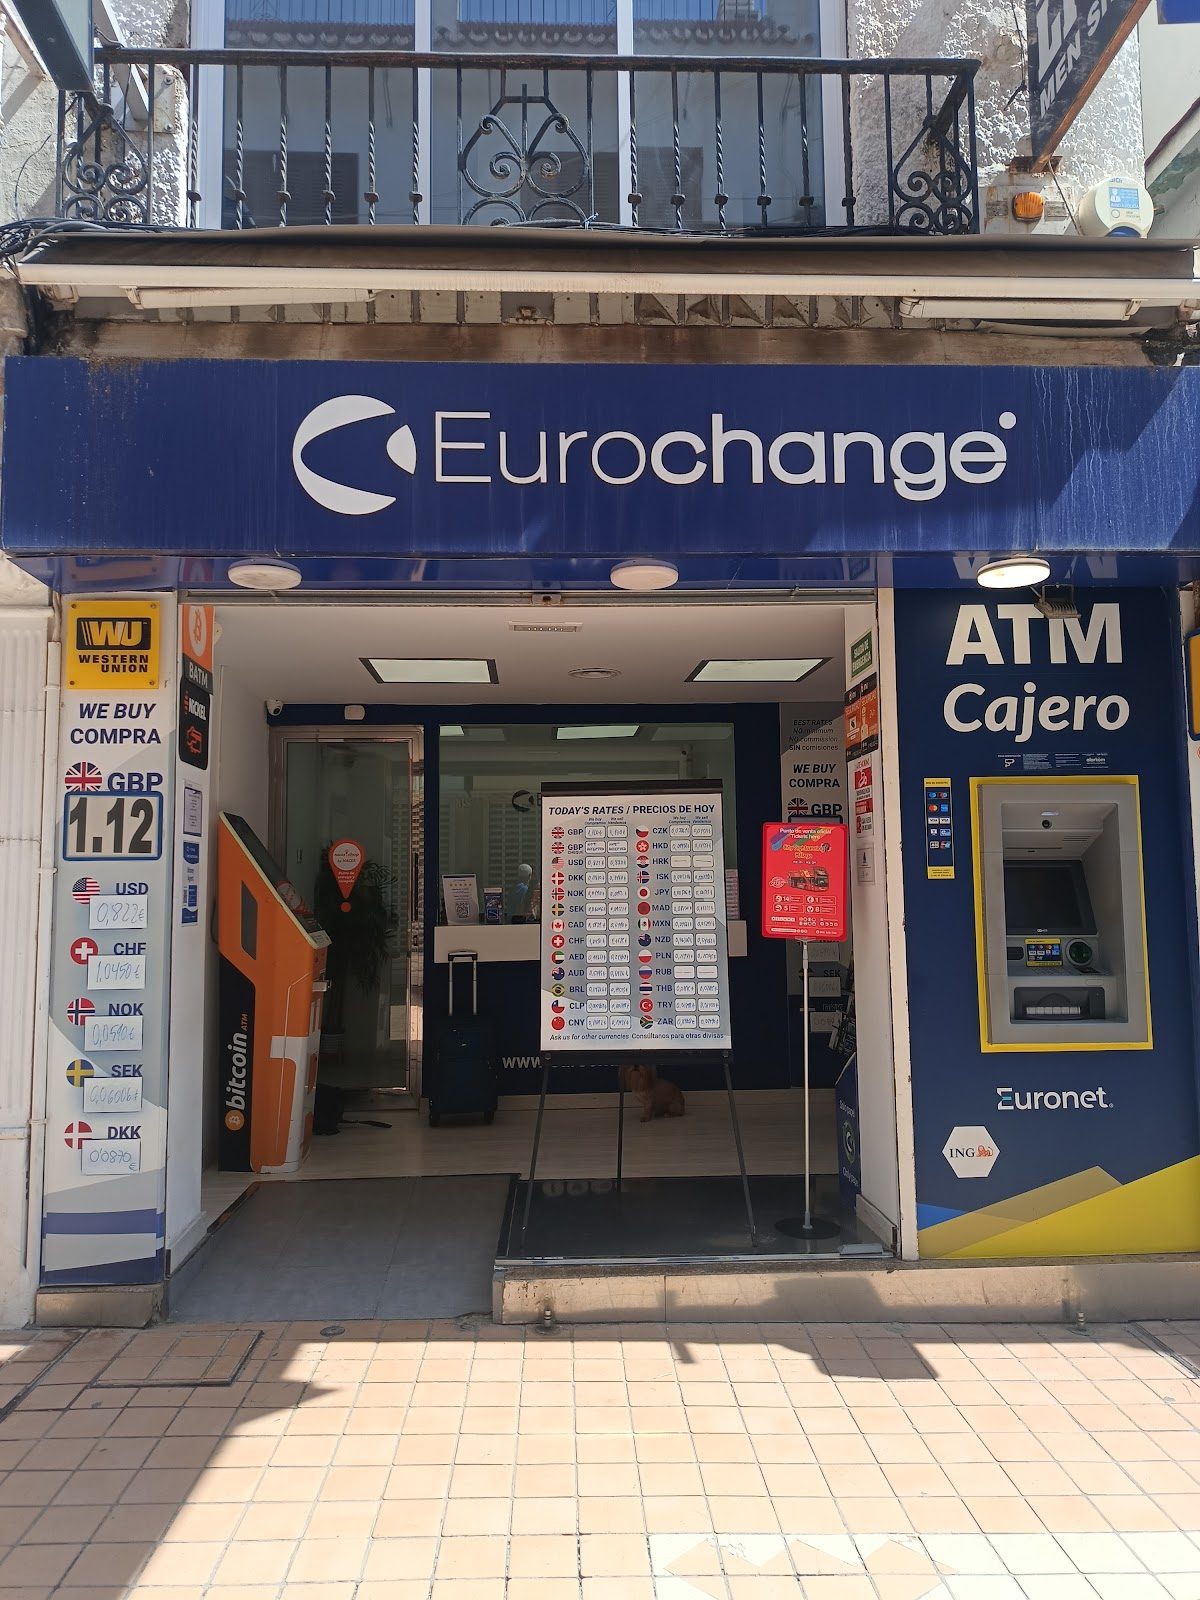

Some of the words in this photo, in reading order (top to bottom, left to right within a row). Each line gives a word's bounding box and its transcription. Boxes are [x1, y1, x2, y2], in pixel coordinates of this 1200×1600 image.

[1040, 29, 1080, 119] MEN
[434, 411, 1007, 501] Eurochange
[81, 621, 143, 647] WU
[946, 603, 1122, 665] ATM
[79, 654, 148, 664] WESTERN
[101, 664, 148, 672] UNION
[189, 661, 208, 689] BATM
[79, 703, 110, 719] WE
[113, 703, 157, 719] BUY
[944, 681, 1129, 742] Cajero
[70, 728, 161, 744] COMPRA
[793, 764, 811, 773] WE
[813, 764, 836, 773] BUY
[107, 772, 164, 792] GBP
[789, 778, 840, 788] COMPRA
[549, 806, 590, 815] TODAY'S
[592, 806, 624, 815] RATES
[633, 805, 676, 814] PRECIOS
[679, 805, 692, 813] DE
[694, 804, 715, 812] HOY
[811, 804, 842, 816] GBP
[69, 797, 154, 854] 1.12
[568, 828, 584, 836] GBP
[116, 882, 149, 895] USD
[654, 888, 670, 896] JPY
[114, 942, 146, 955] CHF
[656, 984, 672, 992] THB
[108, 1003, 144, 1016] NOK
[570, 1002, 584, 1010] CLP
[225, 1032, 248, 1111] bitcoin
[240, 1013, 248, 1031] ATM
[112, 1064, 143, 1077] SEK
[996, 1086, 1108, 1110] Euronet
[108, 1126, 142, 1139] DKK
[950, 1148, 976, 1158] ING
